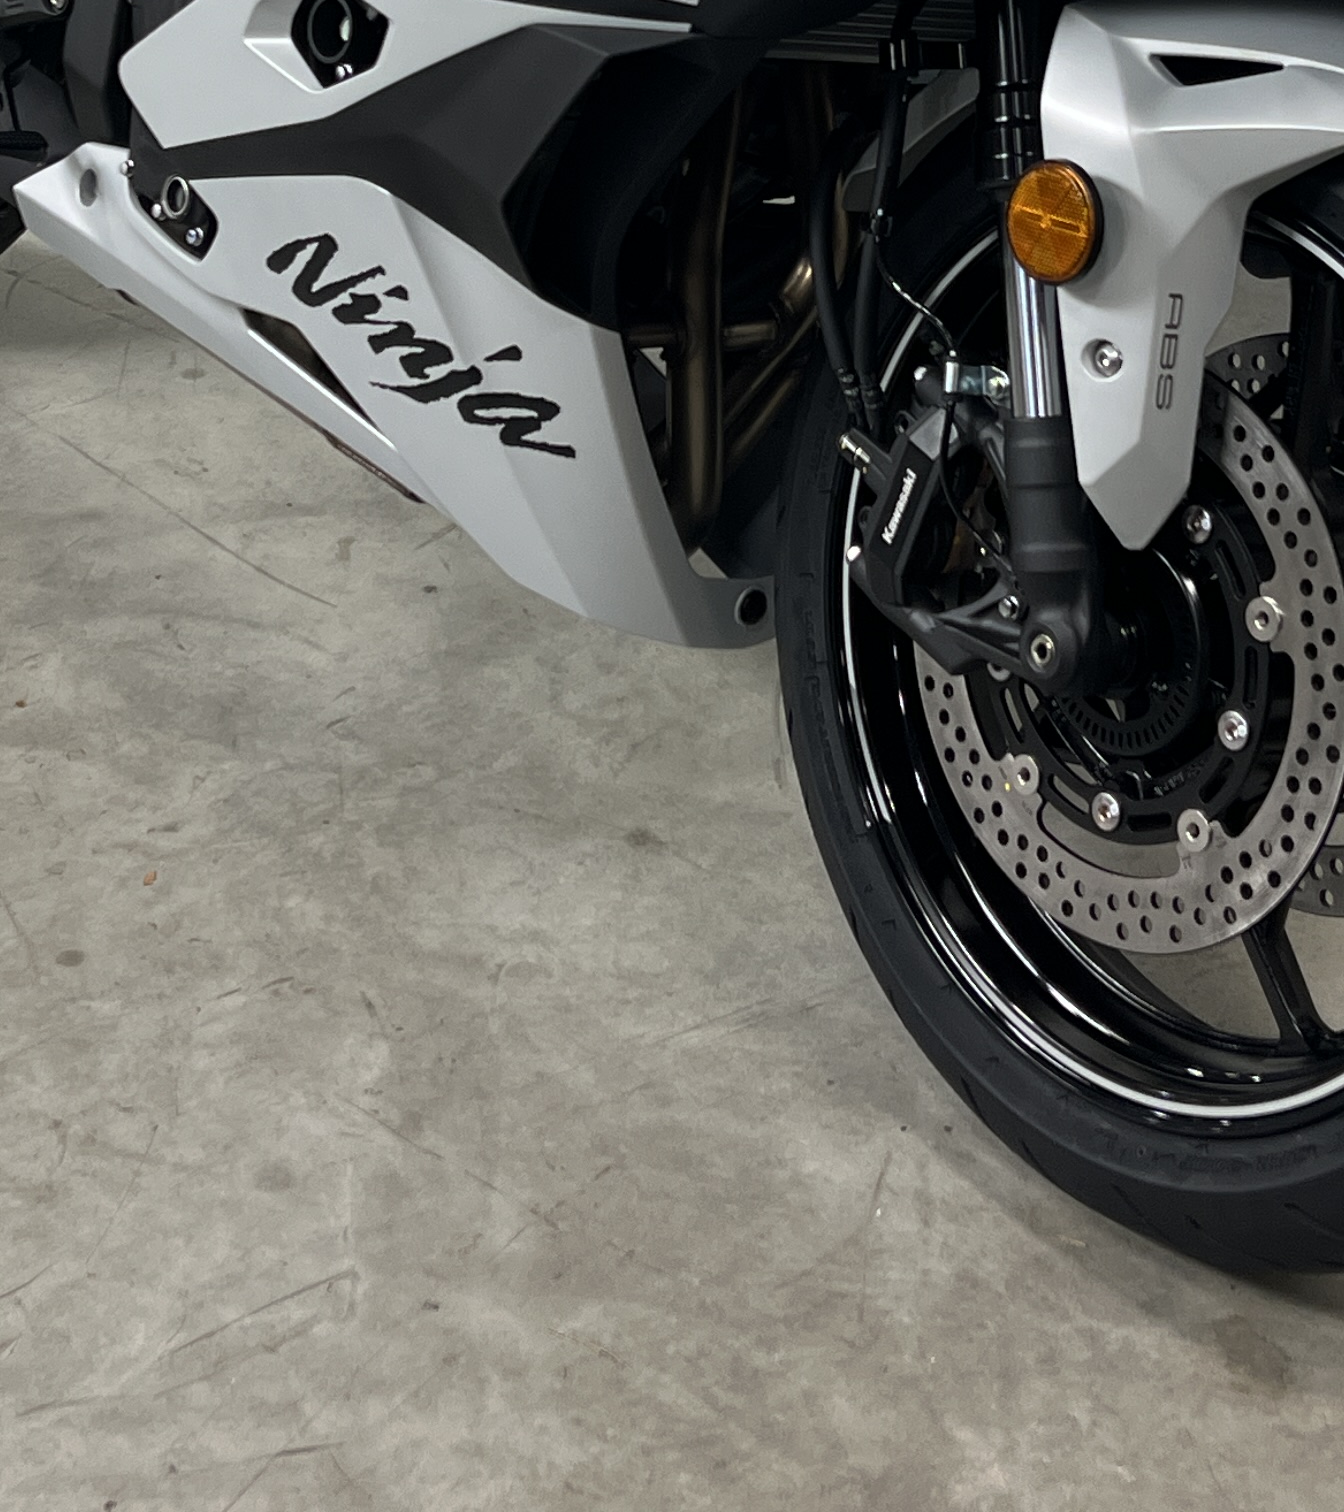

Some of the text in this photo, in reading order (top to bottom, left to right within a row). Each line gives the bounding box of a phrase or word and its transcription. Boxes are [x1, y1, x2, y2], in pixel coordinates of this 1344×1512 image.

[265, 233, 577, 459] Ninja
[1156, 292, 1184, 411] ABS
[880, 467, 918, 545] Kawasaki
